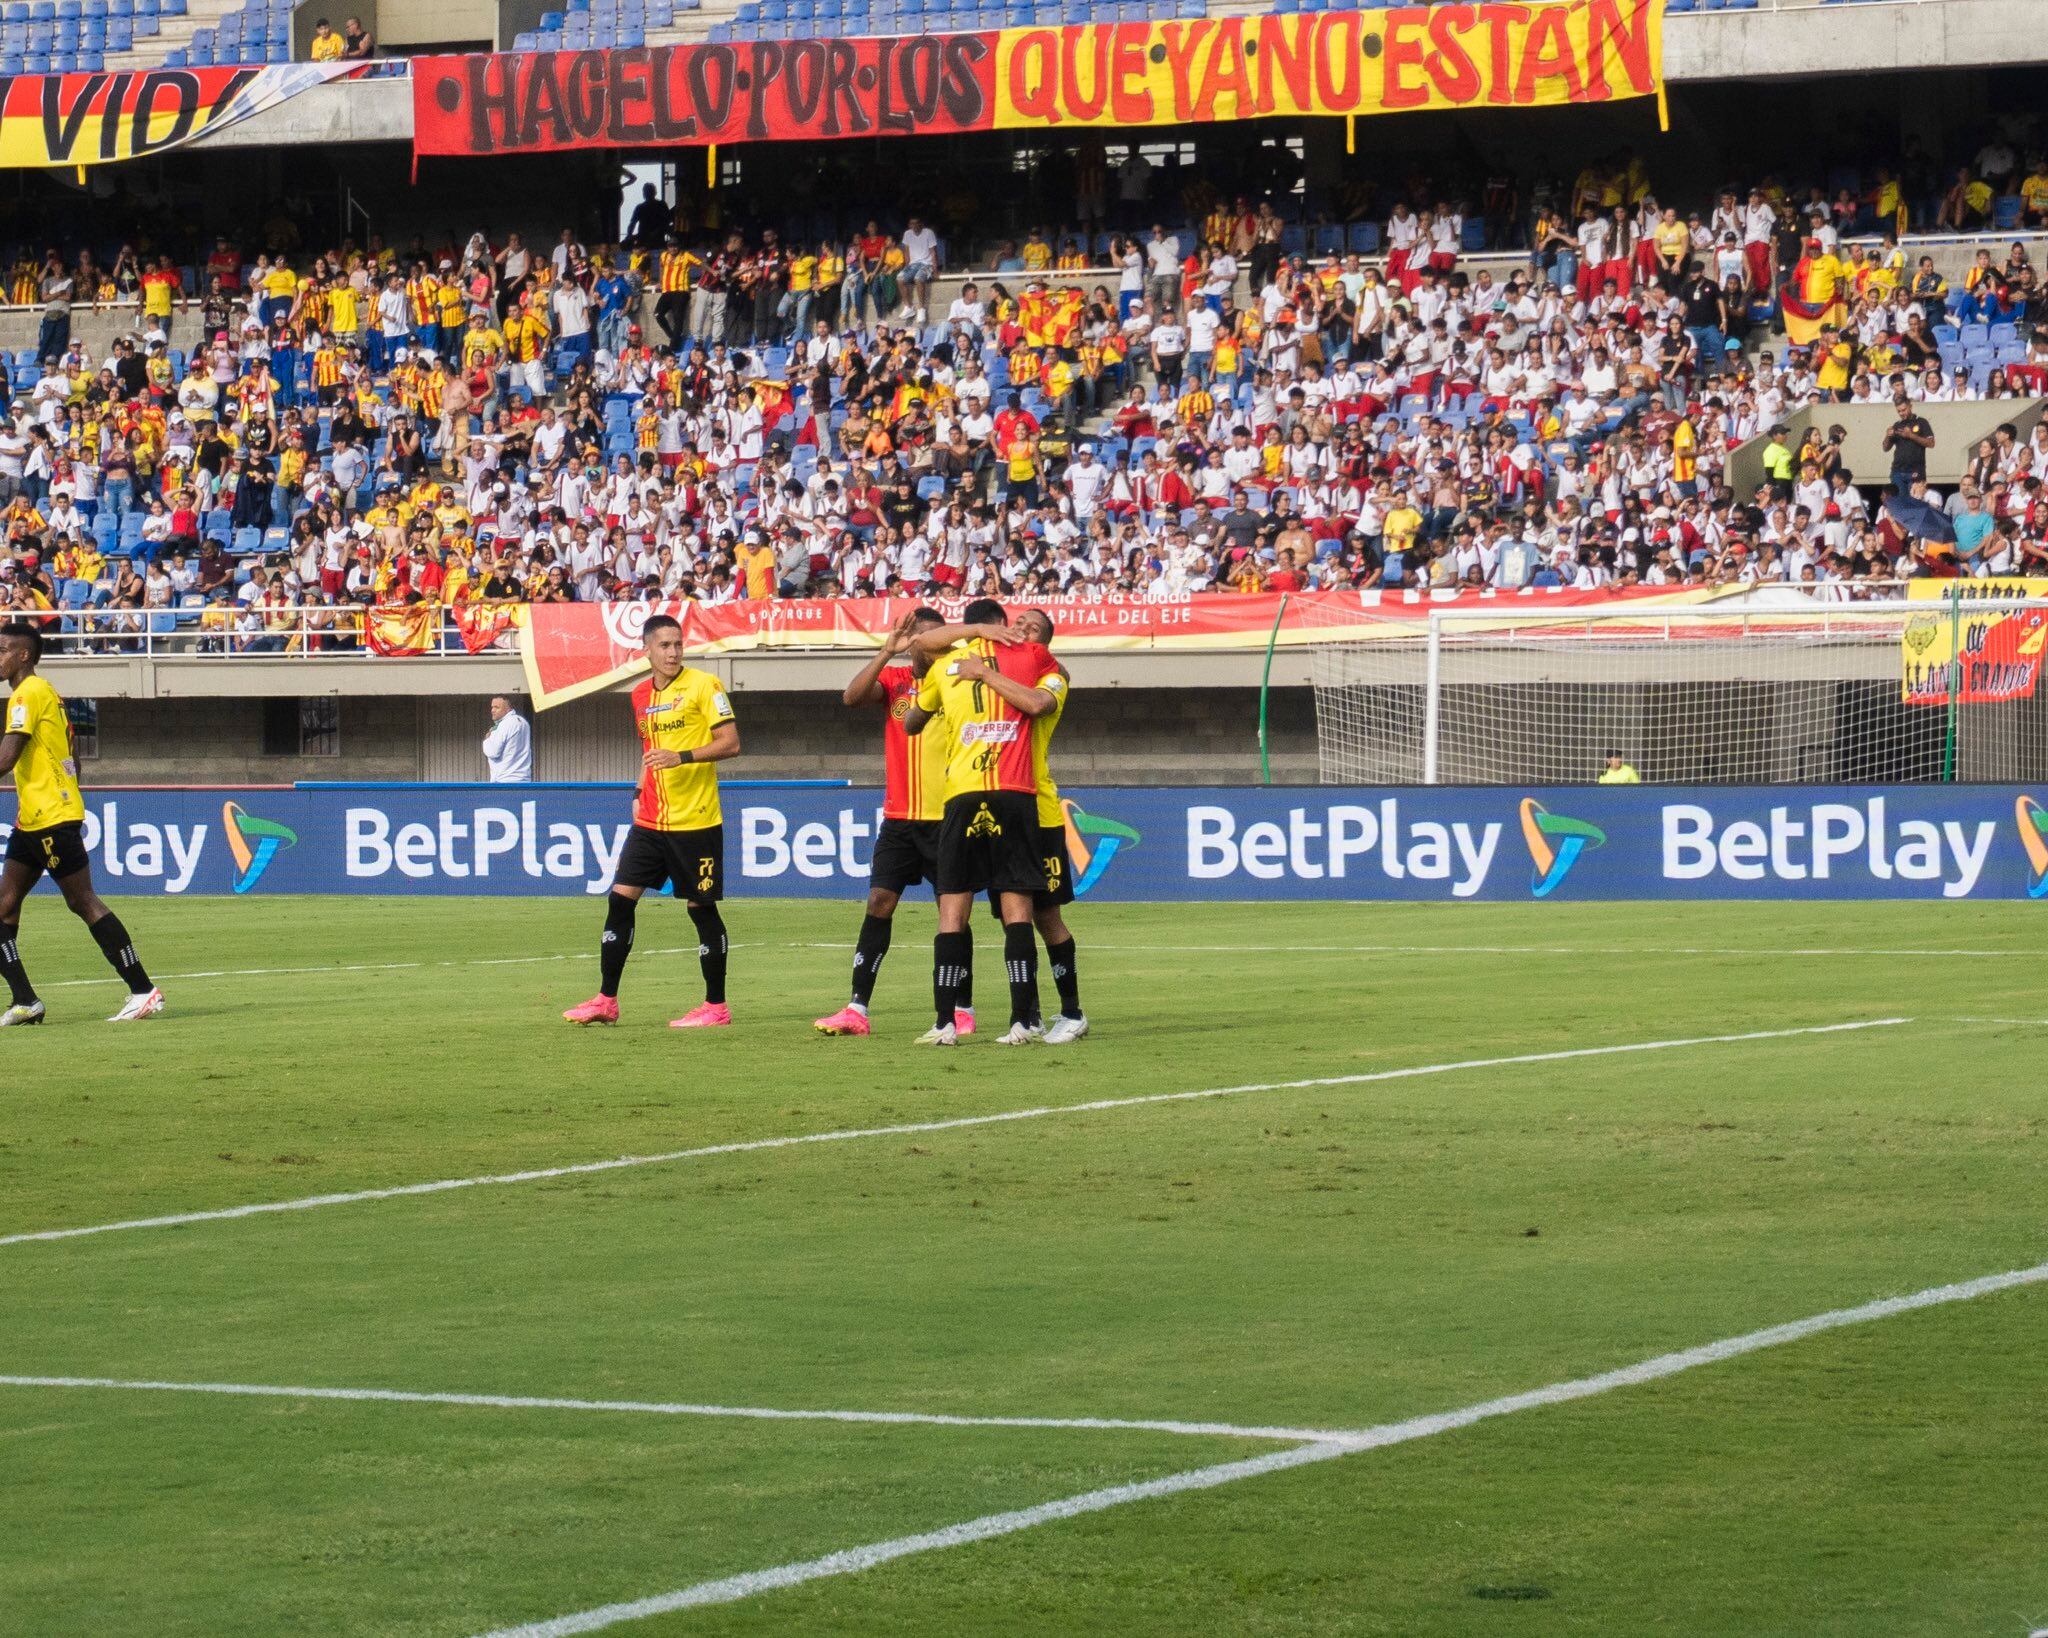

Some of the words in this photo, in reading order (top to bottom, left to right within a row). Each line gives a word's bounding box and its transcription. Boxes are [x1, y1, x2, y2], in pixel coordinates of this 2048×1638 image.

[747, 40, 871, 138] POR
[878, 36, 988, 134] LOS
[1008, 22, 1153, 123] QUE
[1159, 17, 1258, 121] YA
[1255, 12, 1364, 112] NO
[1047, 609, 1108, 624] APITAL
[1118, 609, 1150, 624] DEL
[1161, 607, 1191, 624] EJE
[346, 800, 629, 894] BetPlay
[1187, 798, 1502, 897] BetPlay
[1662, 796, 1996, 897] BetPlay
